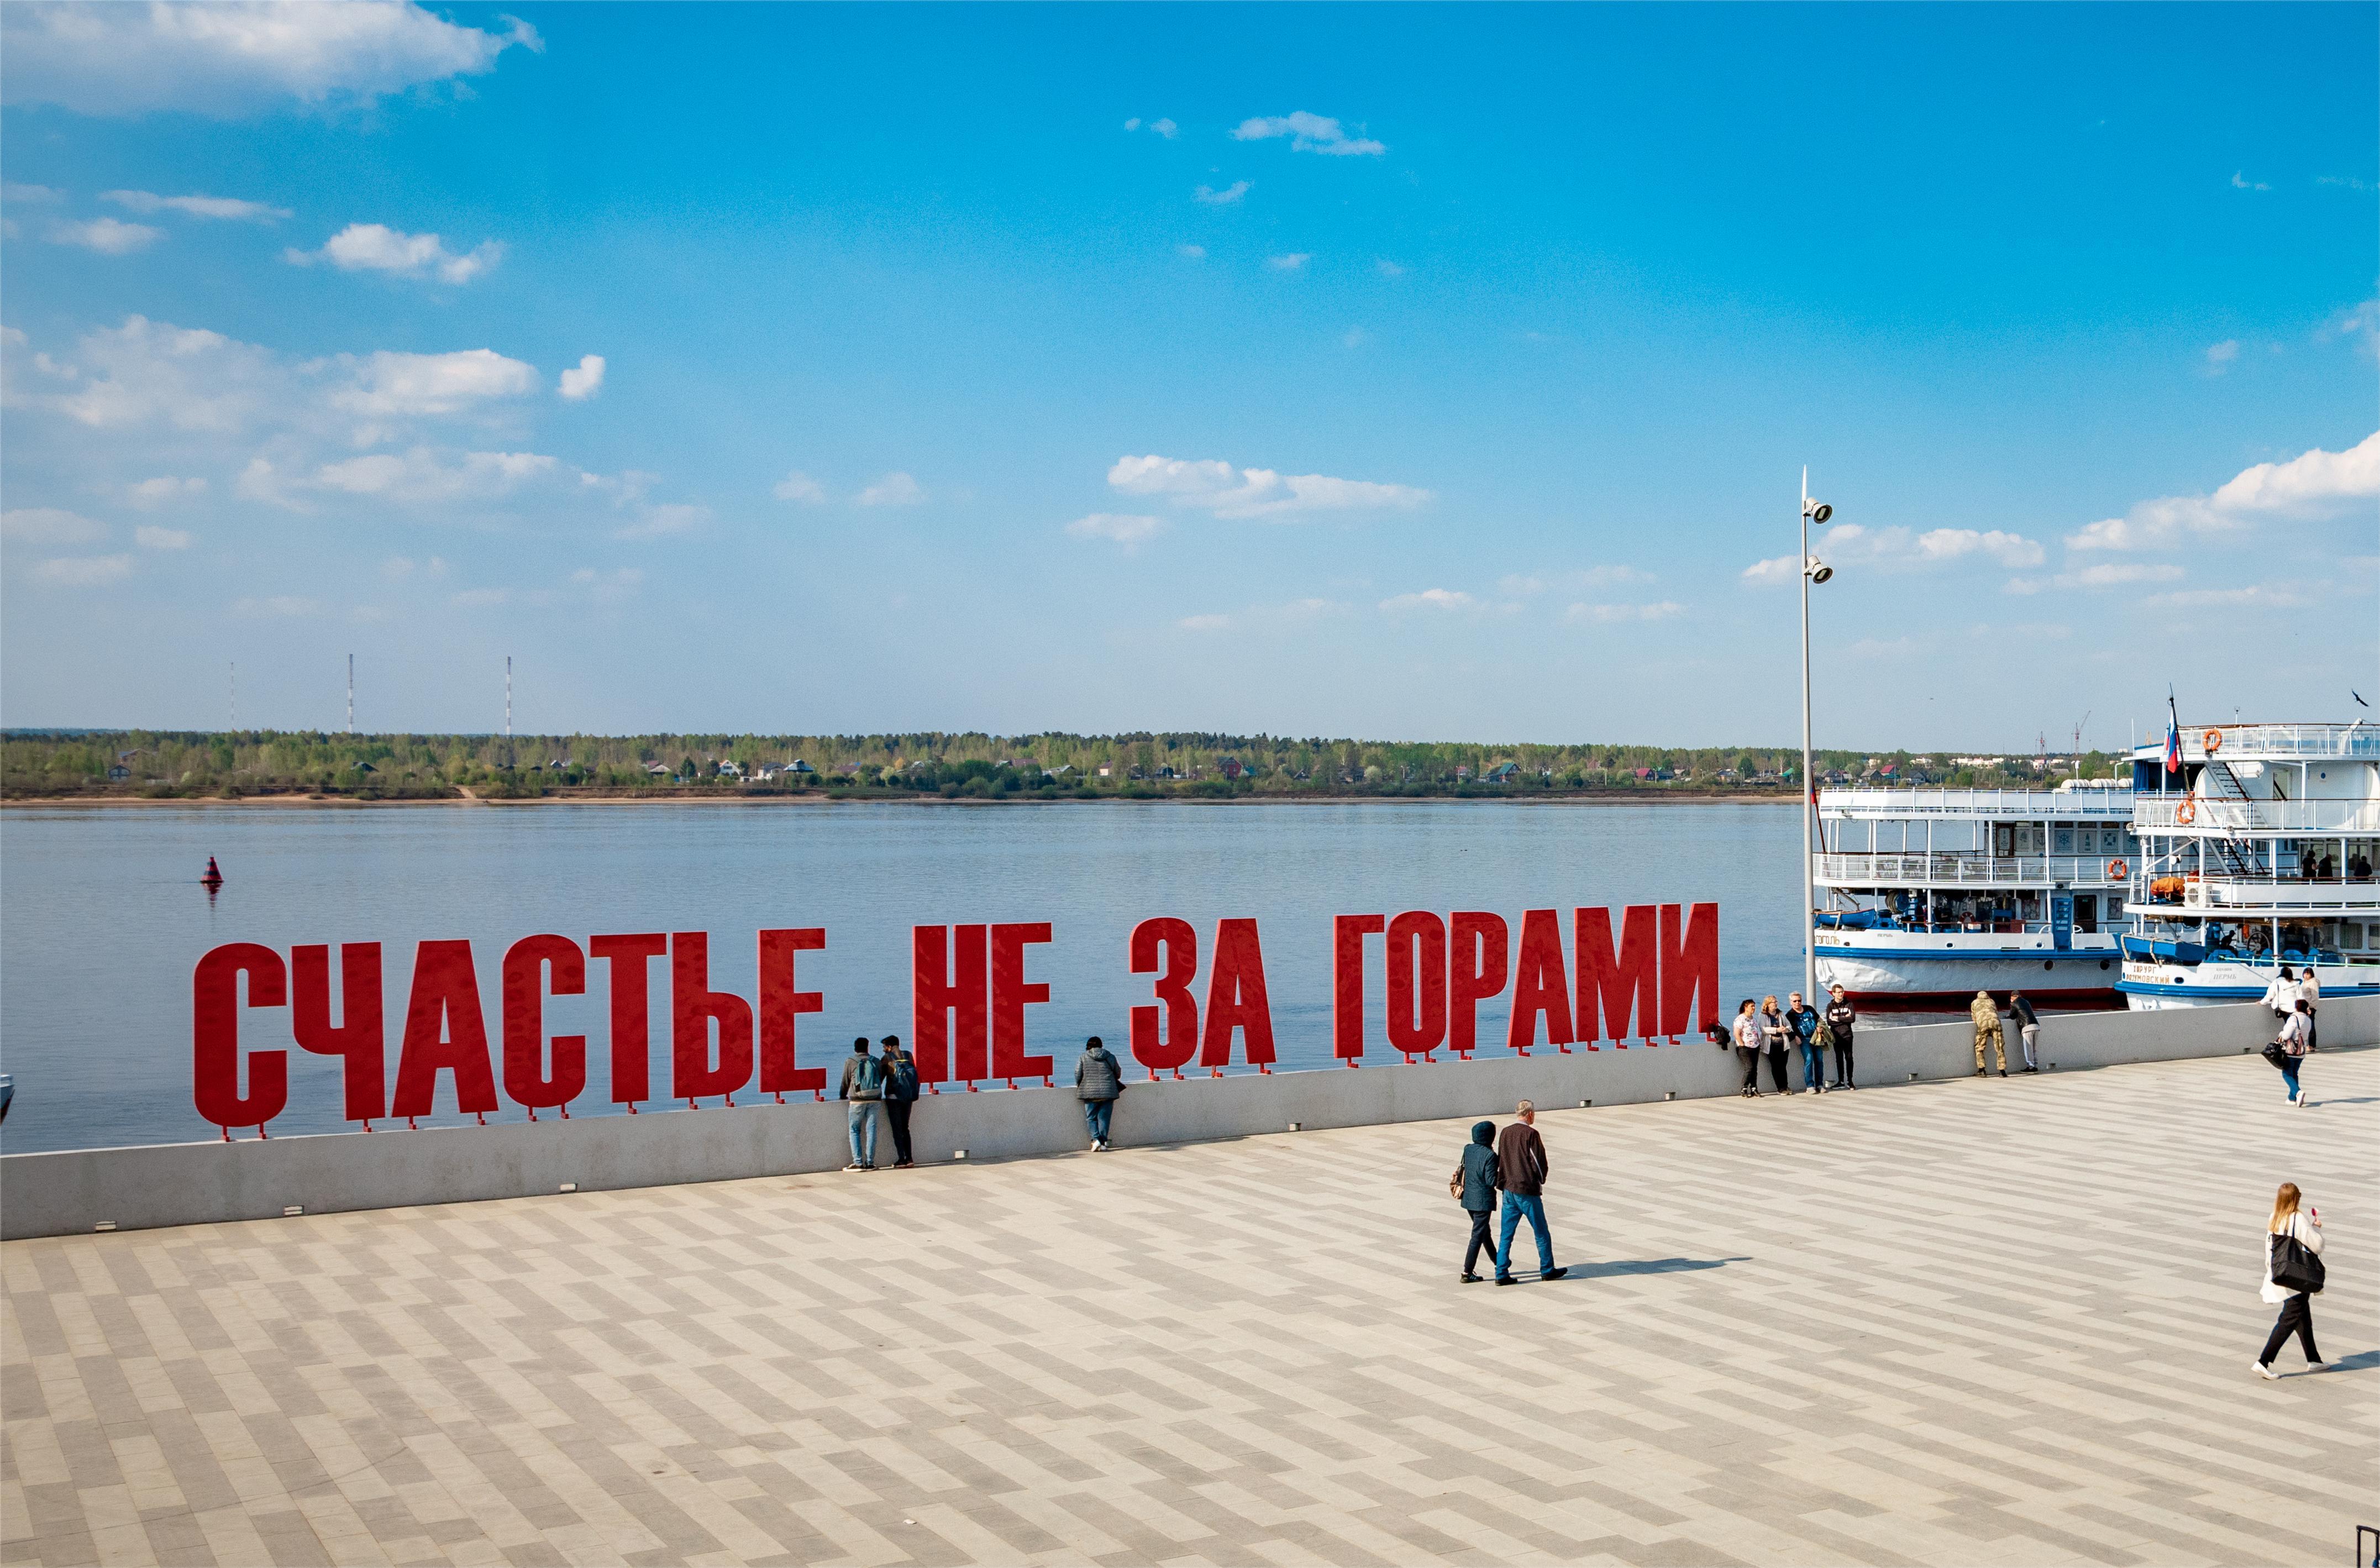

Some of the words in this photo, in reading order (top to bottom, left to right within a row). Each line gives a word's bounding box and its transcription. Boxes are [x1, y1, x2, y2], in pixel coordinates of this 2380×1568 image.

[2134, 966, 2156, 974] ХИРУРГ
[2126, 974, 2170, 984] РАЗУМОВСКИЙ
[193, 928, 827, 1130] СЧАСТЬЕ
[912, 922, 1053, 1092] НЕ
[1129, 917, 1276, 1070] ЗА
[1333, 903, 1720, 1061] ГОРАМИ
